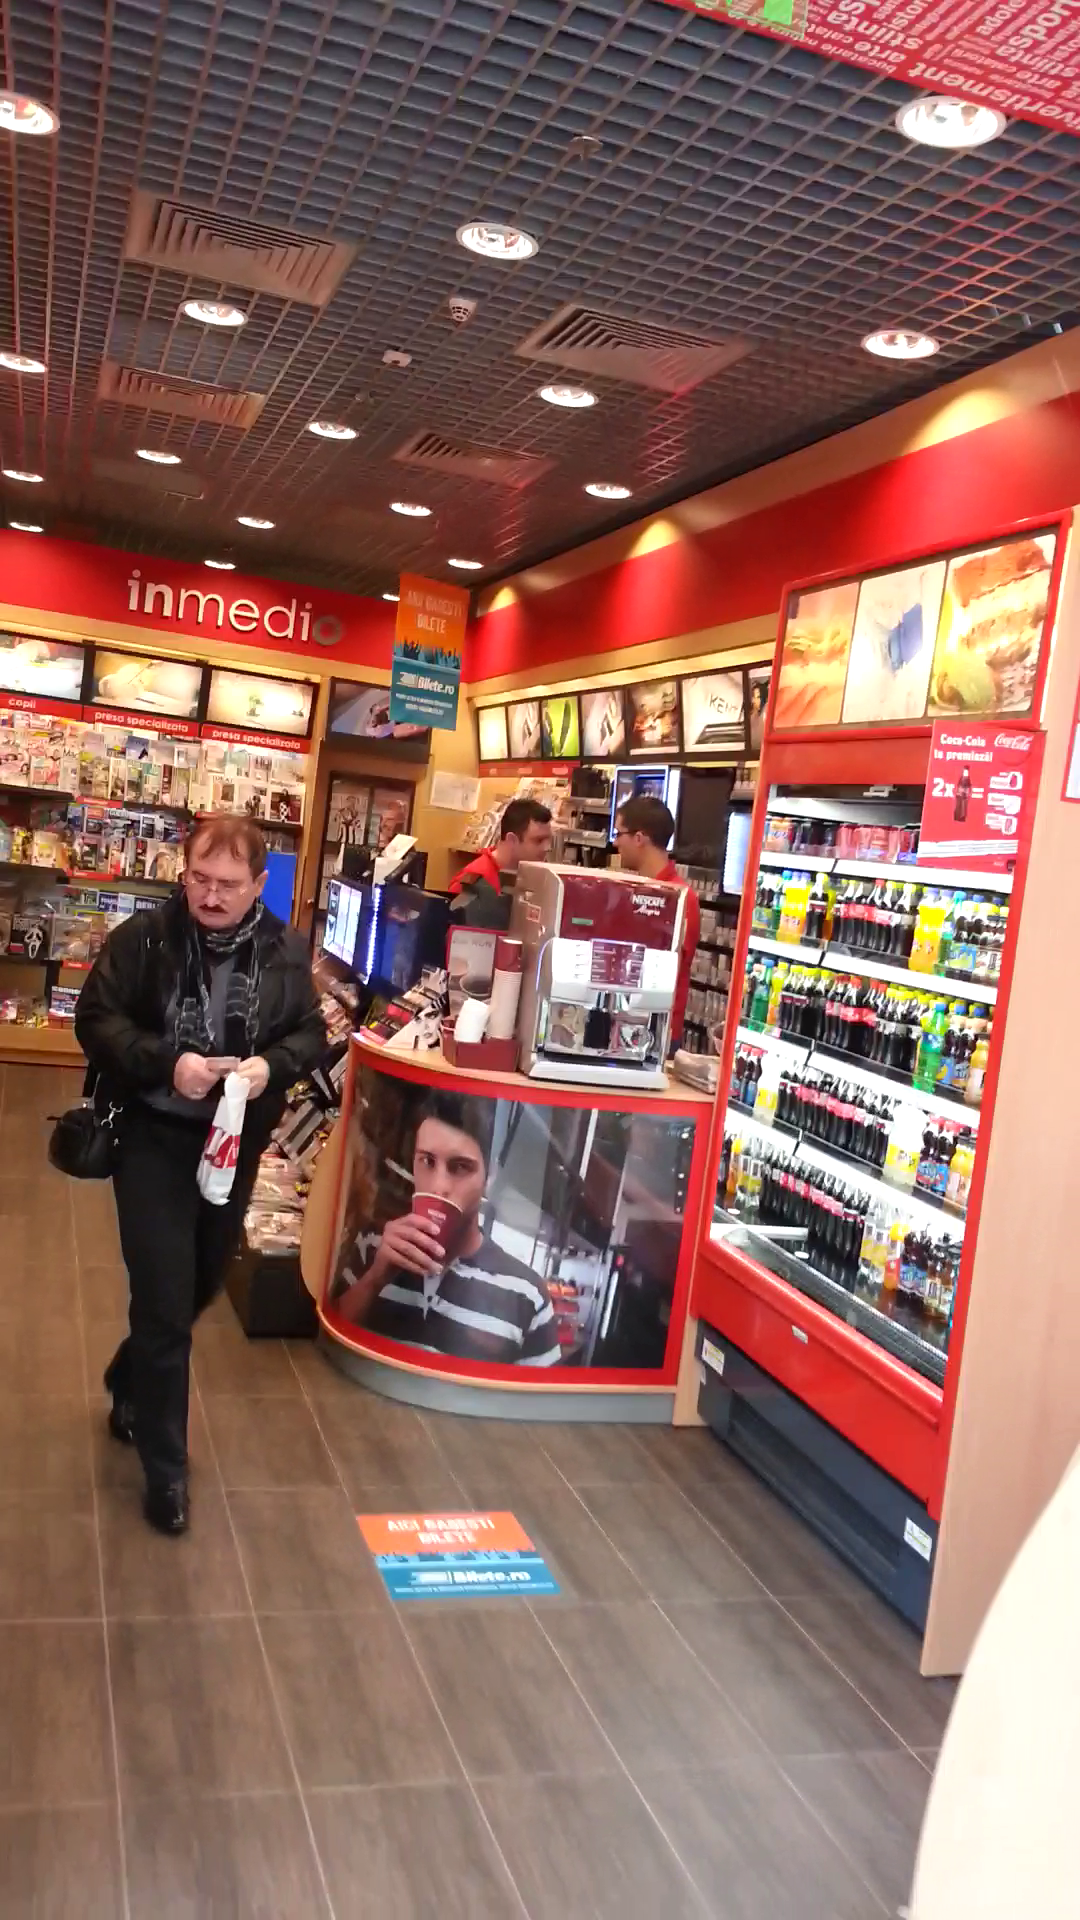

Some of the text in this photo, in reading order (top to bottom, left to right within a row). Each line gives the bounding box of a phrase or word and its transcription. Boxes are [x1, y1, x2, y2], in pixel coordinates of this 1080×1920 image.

[907, 62, 1080, 131] ivertisment
[127, 569, 343, 646] inmedio
[95, 711, 189, 733] presa specializata
[212, 730, 301, 749] presa specializata
[940, 733, 986, 747] Coca-Cola
[931, 777, 955, 797] 2x
